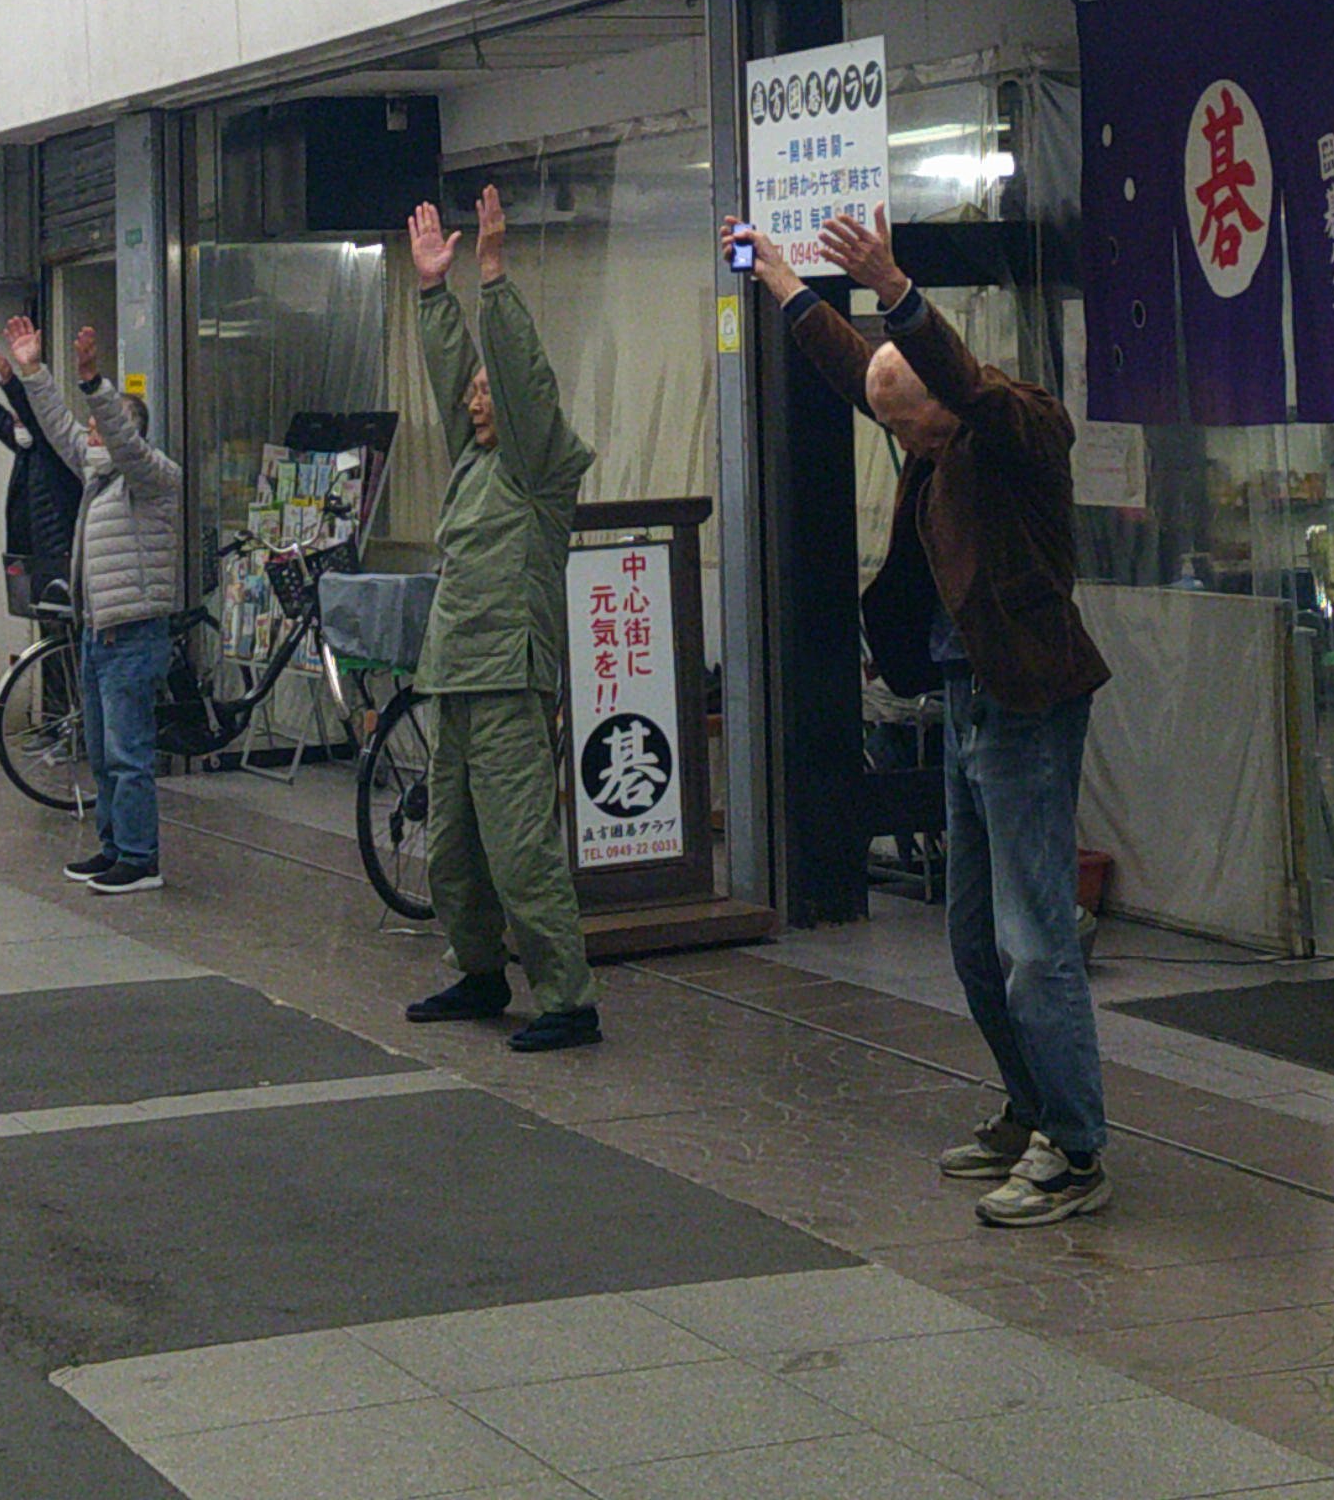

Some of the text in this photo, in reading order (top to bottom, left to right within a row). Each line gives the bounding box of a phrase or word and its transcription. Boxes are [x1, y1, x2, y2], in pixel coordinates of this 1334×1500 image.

[752, 63, 883, 124] 直方囲碁クラブ
[1194, 86, 1266, 271] 碁
[771, 208, 803, 234] 定休日
[622, 551, 653, 677] 中心街に
[594, 719, 669, 809] 碁
[583, 847, 604, 861] TEL
